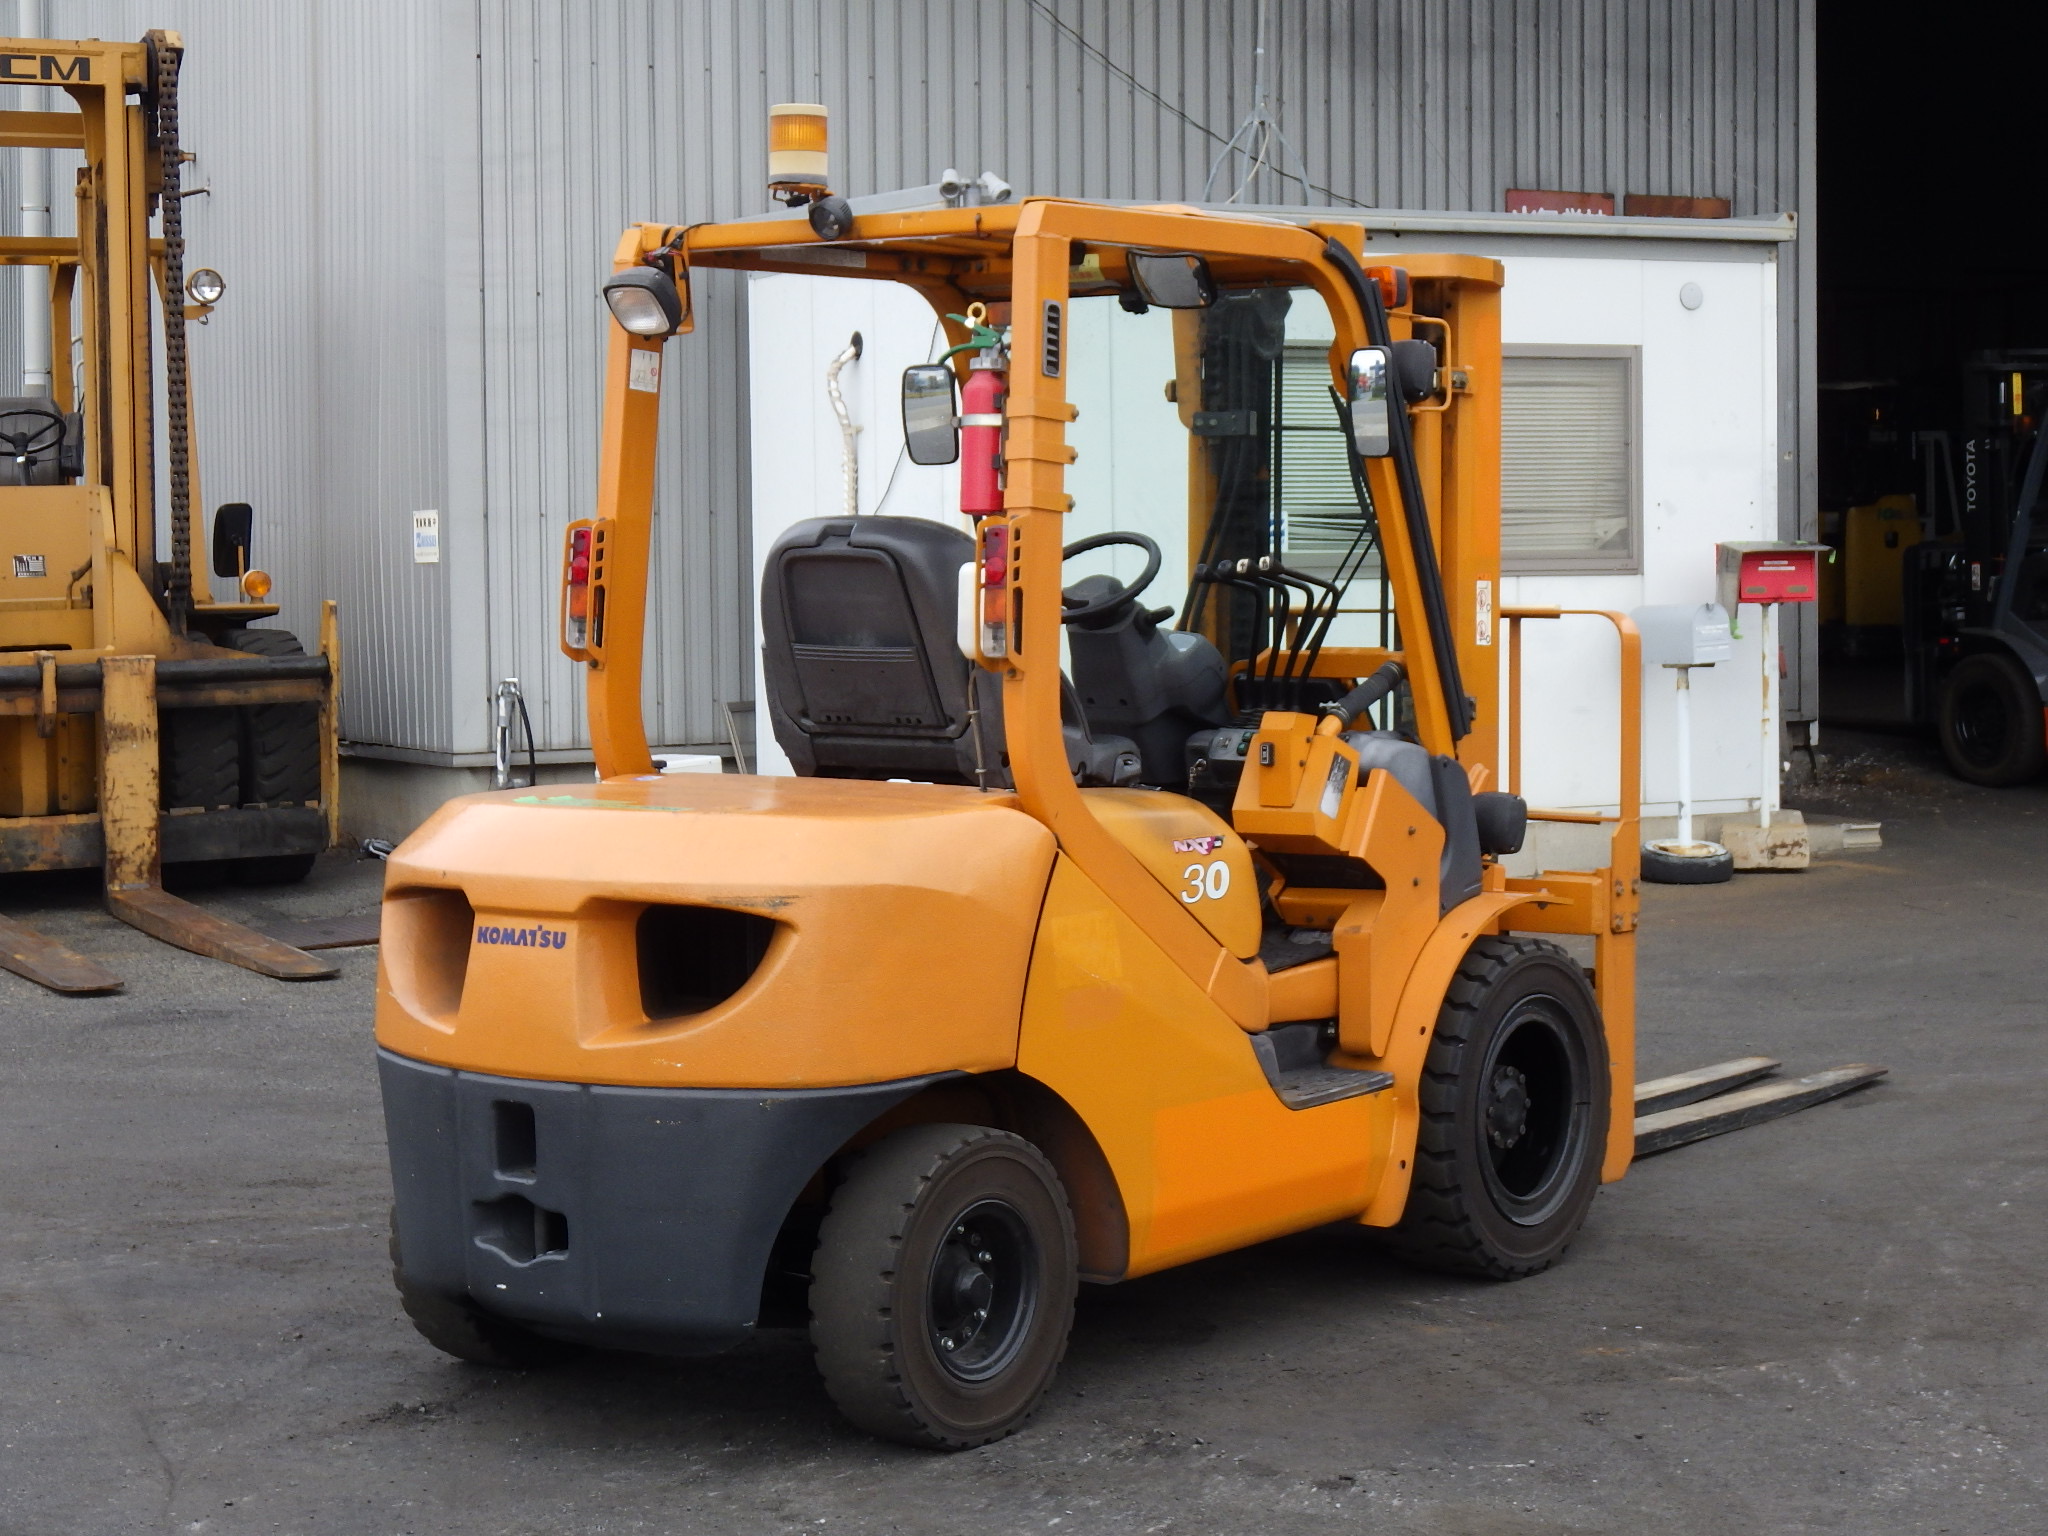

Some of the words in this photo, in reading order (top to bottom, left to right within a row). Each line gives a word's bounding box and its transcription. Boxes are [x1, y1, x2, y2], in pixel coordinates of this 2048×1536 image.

[1966, 439, 1977, 512] TOYOTA
[1173, 836, 1212, 855] NXT
[1181, 860, 1230, 904] 30
[477, 925, 567, 949] KOMATSU
